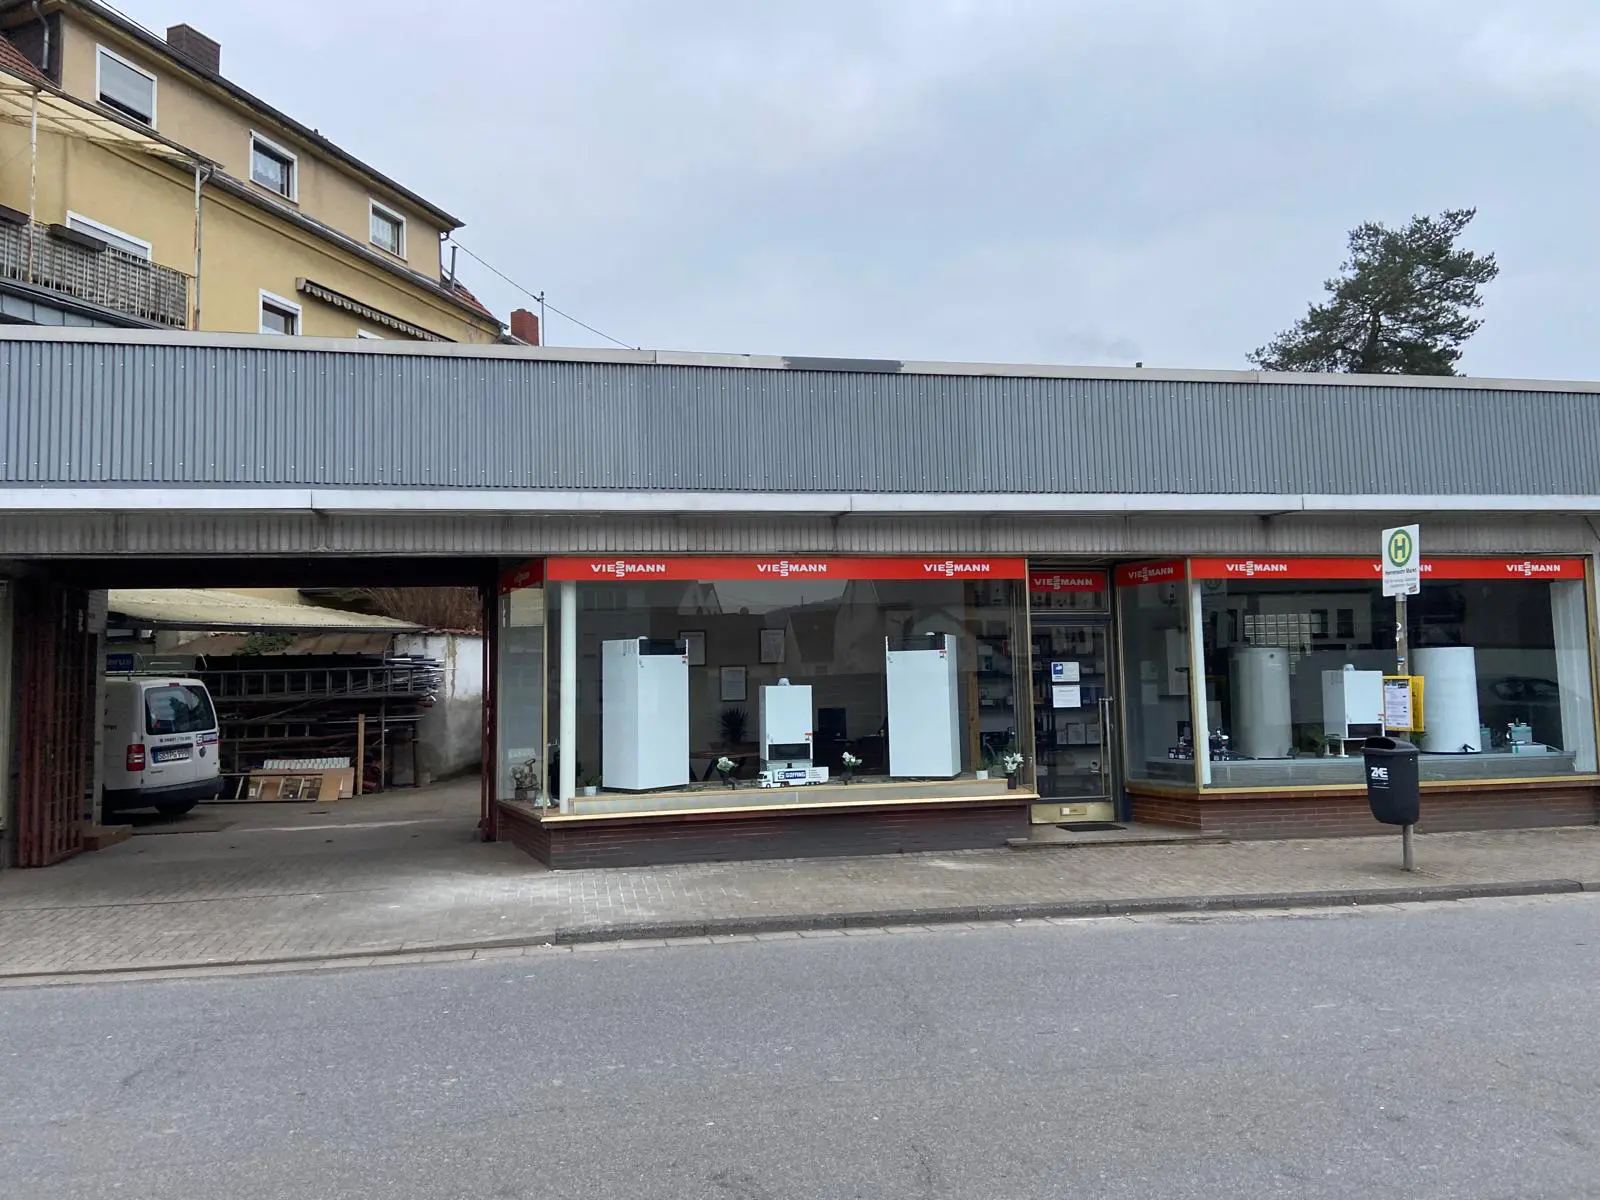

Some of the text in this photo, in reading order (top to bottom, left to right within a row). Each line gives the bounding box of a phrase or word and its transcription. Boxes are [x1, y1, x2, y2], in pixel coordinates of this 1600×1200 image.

[1394, 538, 1406, 559] H
[591, 561, 666, 577] VIESSMANN
[756, 560, 827, 577] VIESSMANN
[923, 560, 990, 577] VIESSMANN
[1128, 566, 1174, 582] VIESSMANN
[1226, 560, 1288, 576] VIESSMANN
[1506, 561, 1561, 576] VIESSMANN
[1034, 575, 1093, 590] VIESSMANN
